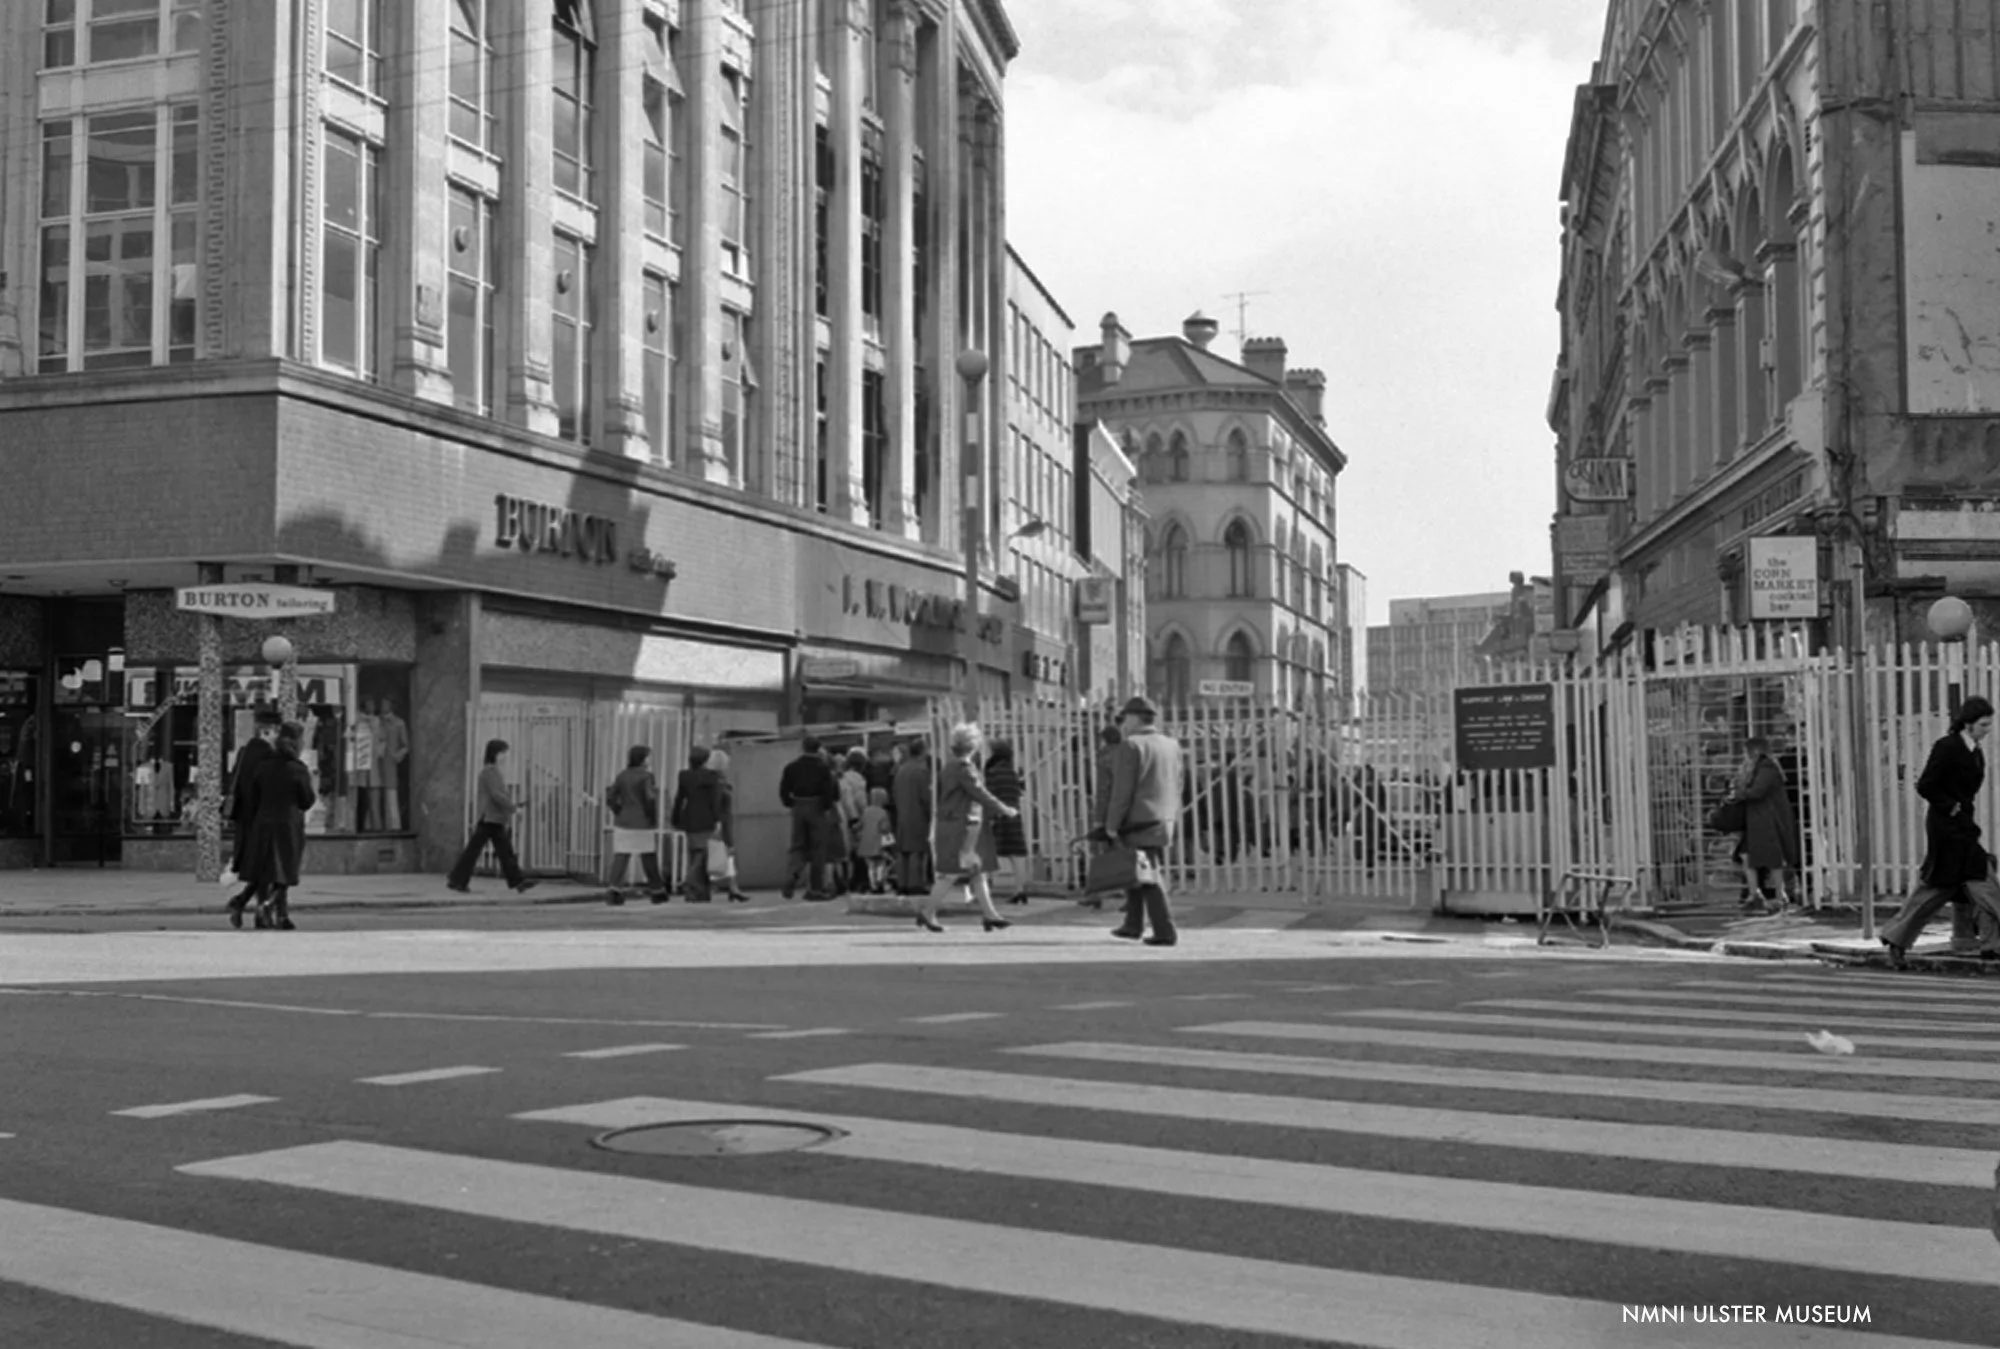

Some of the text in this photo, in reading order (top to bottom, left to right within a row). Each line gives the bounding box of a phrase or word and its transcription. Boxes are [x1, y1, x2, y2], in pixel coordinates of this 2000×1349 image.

[495, 493, 617, 565] BURTON
[1753, 568, 1791, 579] CORN
[1753, 579, 1816, 591] MARKET
[184, 591, 328, 612] BURTON tailoring
